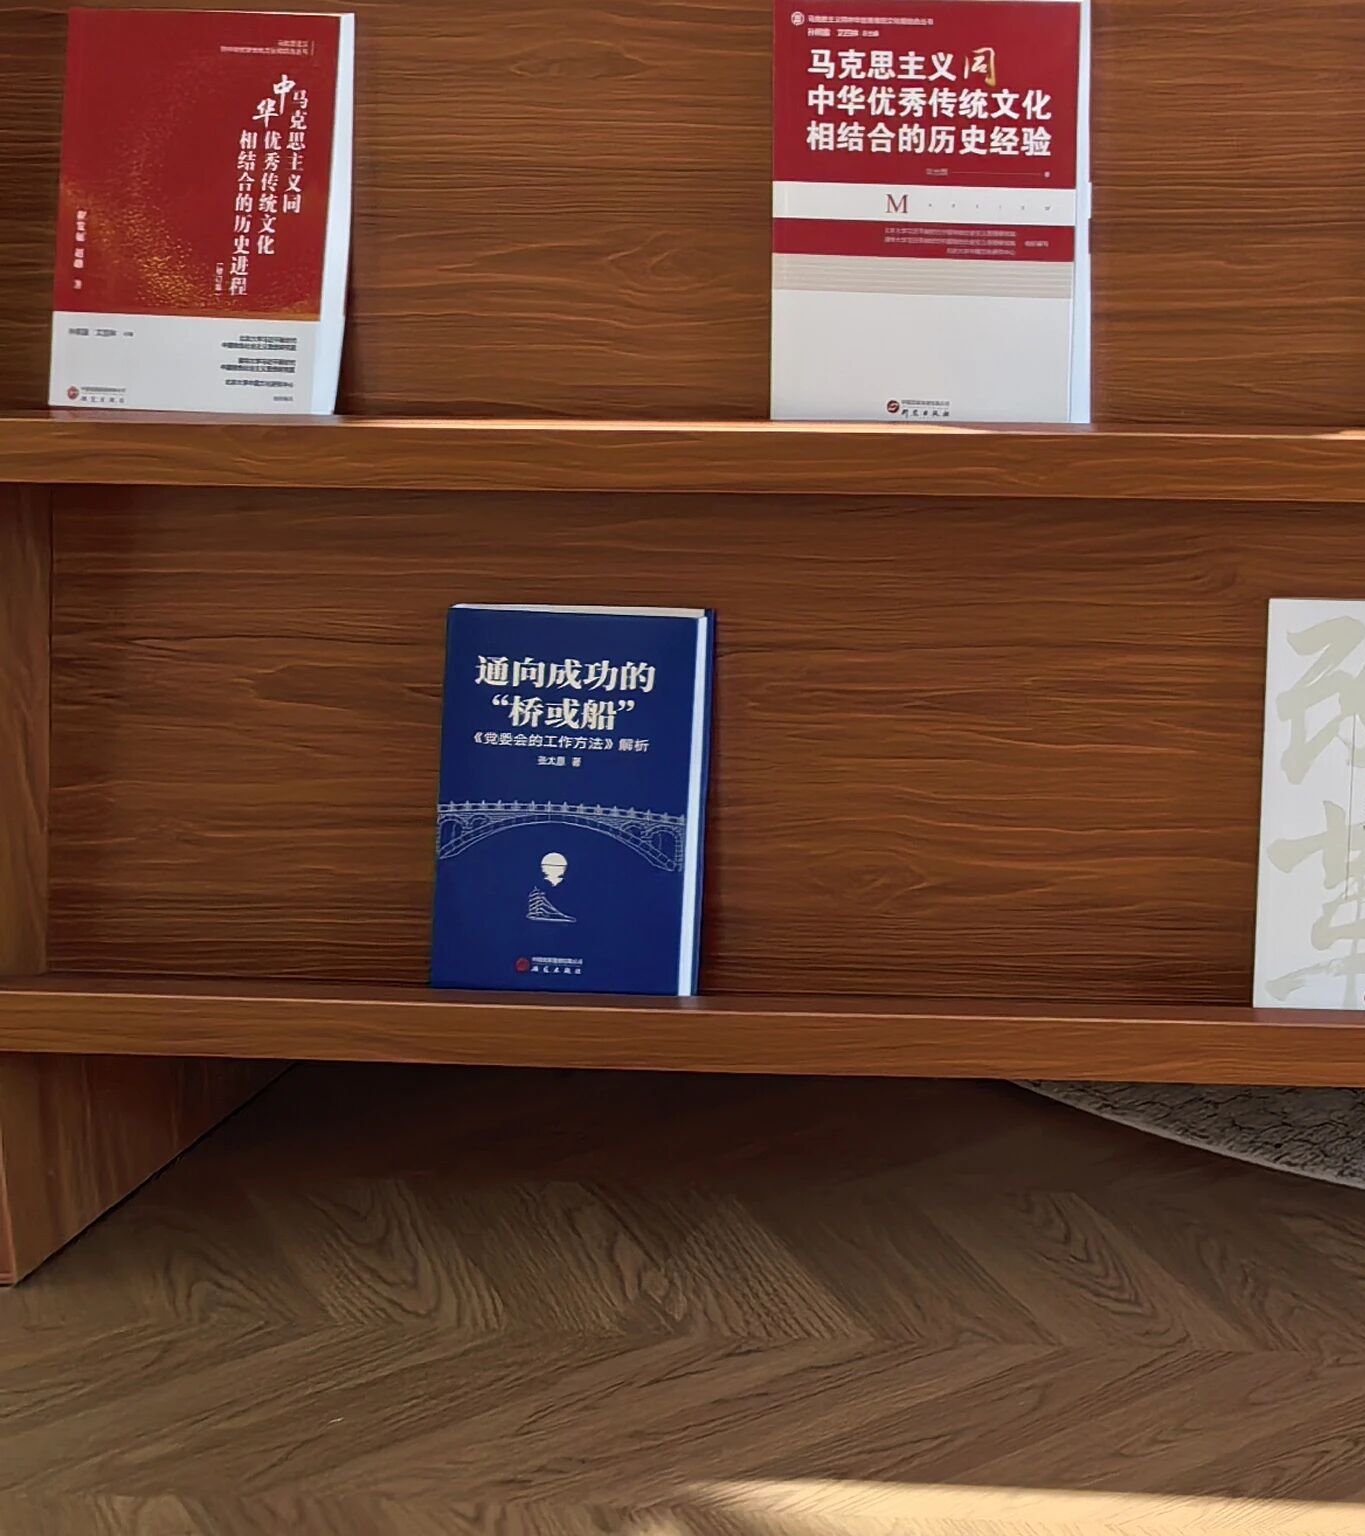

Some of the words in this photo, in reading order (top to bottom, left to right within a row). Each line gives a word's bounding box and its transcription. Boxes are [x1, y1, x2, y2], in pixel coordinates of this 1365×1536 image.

[806, 84, 1052, 121] 中华优秀传统文化
[282, 89, 309, 214] 马克思主义同
[806, 120, 1052, 157] 相结合的历史经验
[228, 129, 258, 296] 相结合的历史进程
[474, 655, 656, 693] 通向成功的
[491, 694, 635, 731] “桥或船”
